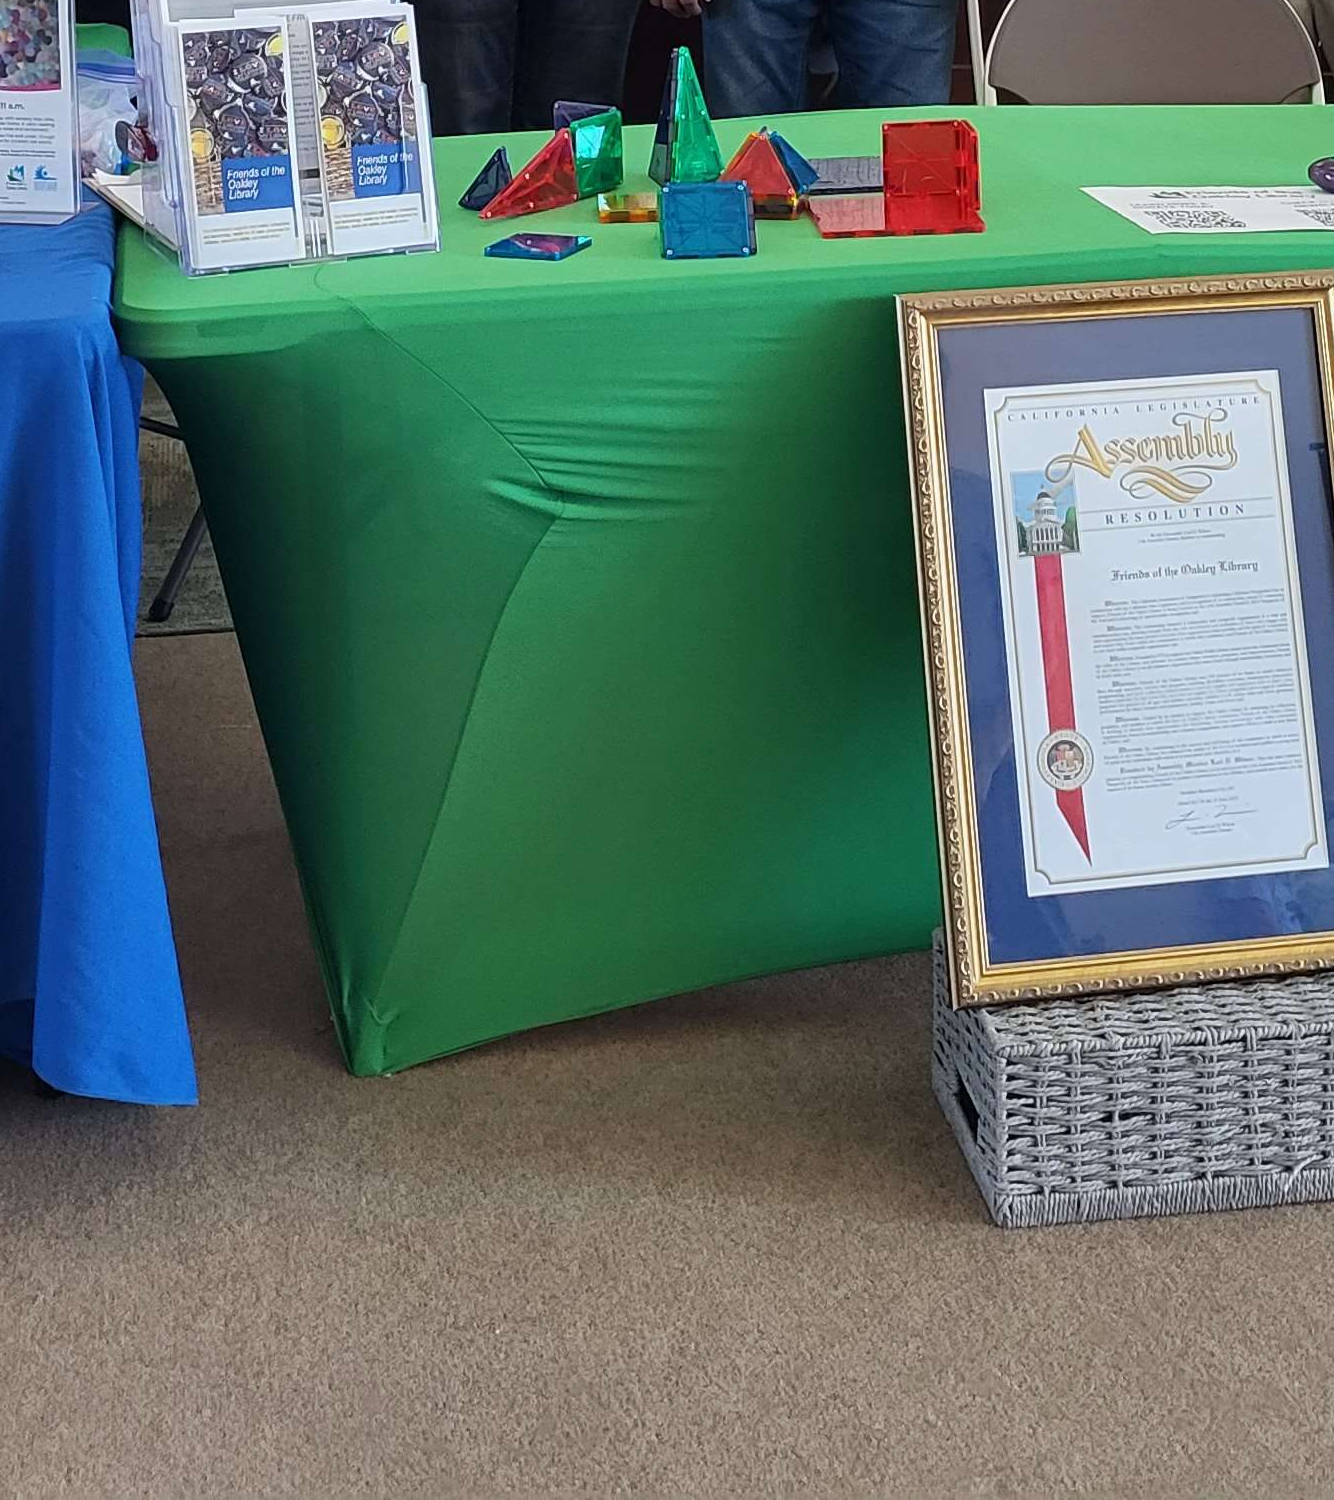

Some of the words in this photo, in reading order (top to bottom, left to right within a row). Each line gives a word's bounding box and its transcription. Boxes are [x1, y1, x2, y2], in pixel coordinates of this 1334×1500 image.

[357, 154, 388, 166] Friends
[389, 153, 398, 163] of
[227, 168, 259, 180] Friends
[261, 168, 269, 177] of
[271, 166, 285, 176] the
[358, 164, 387, 176] Oakley
[228, 178, 258, 190] Oakley
[358, 174, 388, 186] Library
[228, 188, 259, 200] Library
[1007, 406, 1120, 422] CALIFORNIA
[1136, 396, 1260, 413] LEGISLATURE
[1045, 408, 1238, 484] Assembly
[1105, 504, 1245, 525] RESOLUTION
[1111, 569, 1151, 582] Friends
[1152, 568, 1162, 579] of
[1164, 566, 1178, 580] the
[1180, 563, 1216, 576] Oakley
[1218, 560, 1259, 573] Library
